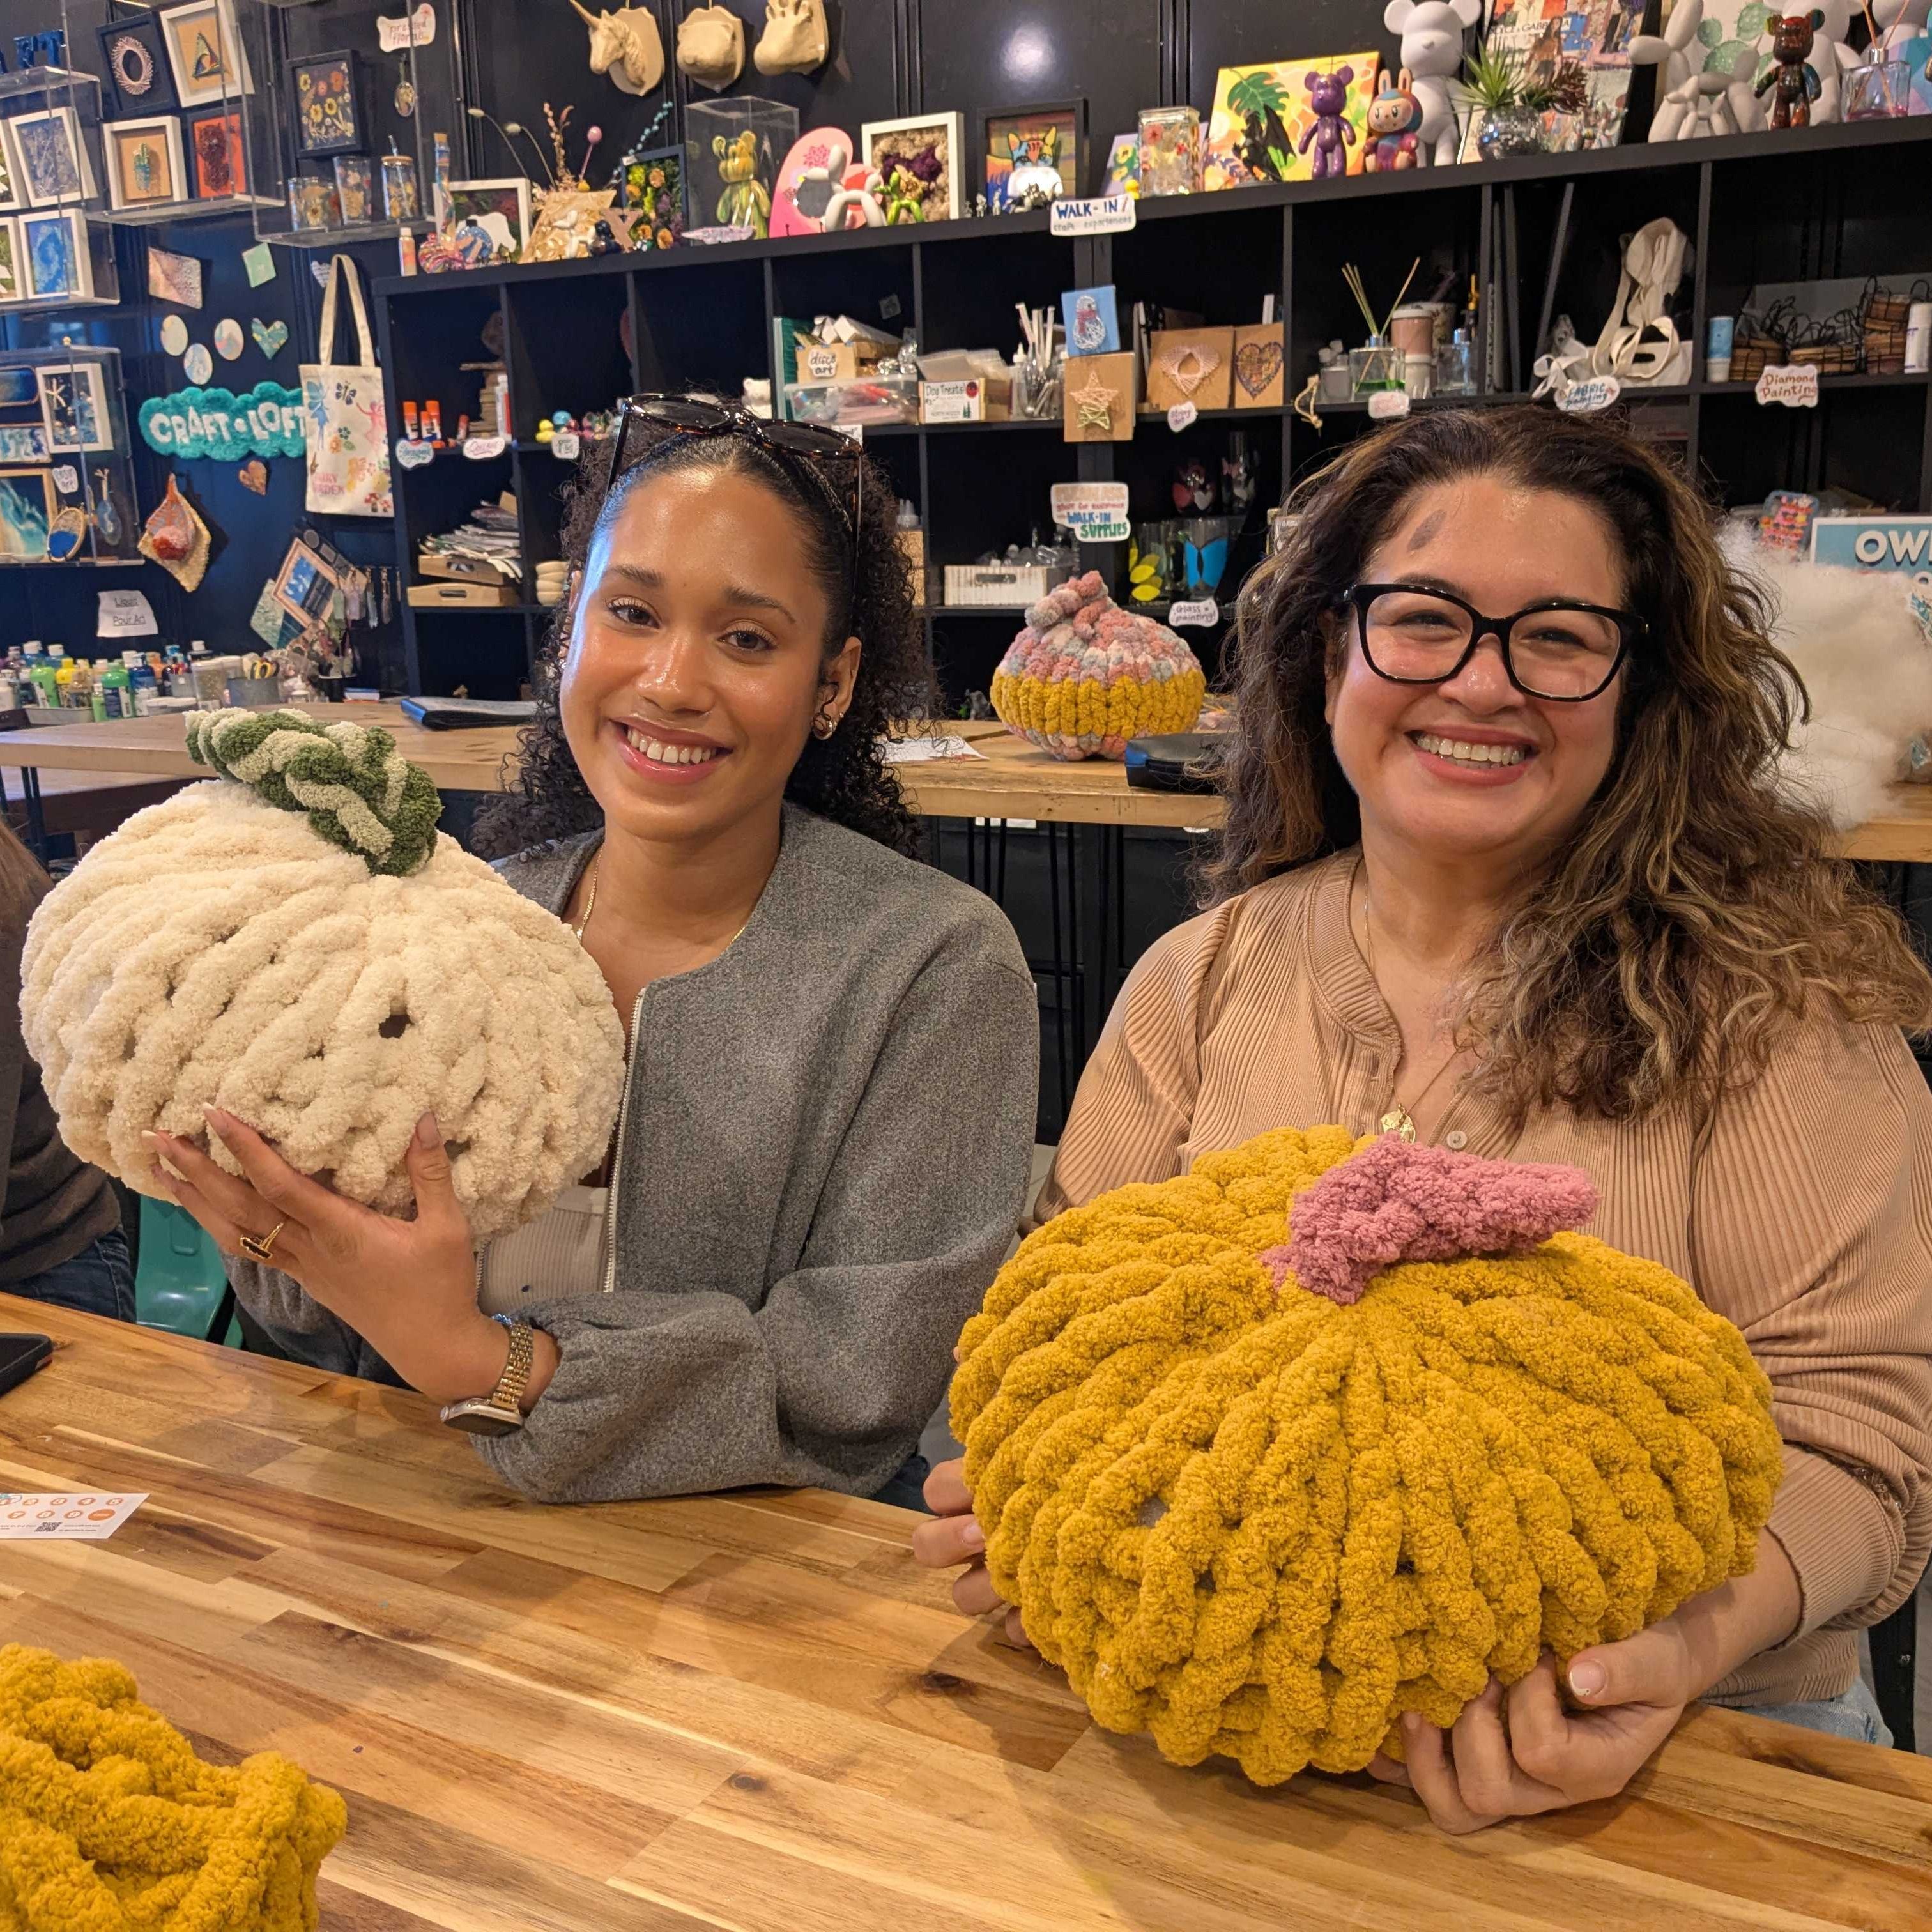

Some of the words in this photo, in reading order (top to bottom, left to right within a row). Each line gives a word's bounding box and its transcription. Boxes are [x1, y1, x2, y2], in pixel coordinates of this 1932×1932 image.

[1522, 19, 1570, 31] GABBA
[815, 365, 833, 374] art
[1765, 374, 1814, 385] Diamond
[1568, 383, 1605, 398] FABRIC
[1761, 384, 1818, 403] Painting
[150, 406, 232, 445] CRAFT
[247, 401, 308, 440] LOFT
[1067, 512, 1111, 523] WALK-IN
[1080, 523, 1128, 538] SUPPLIES
